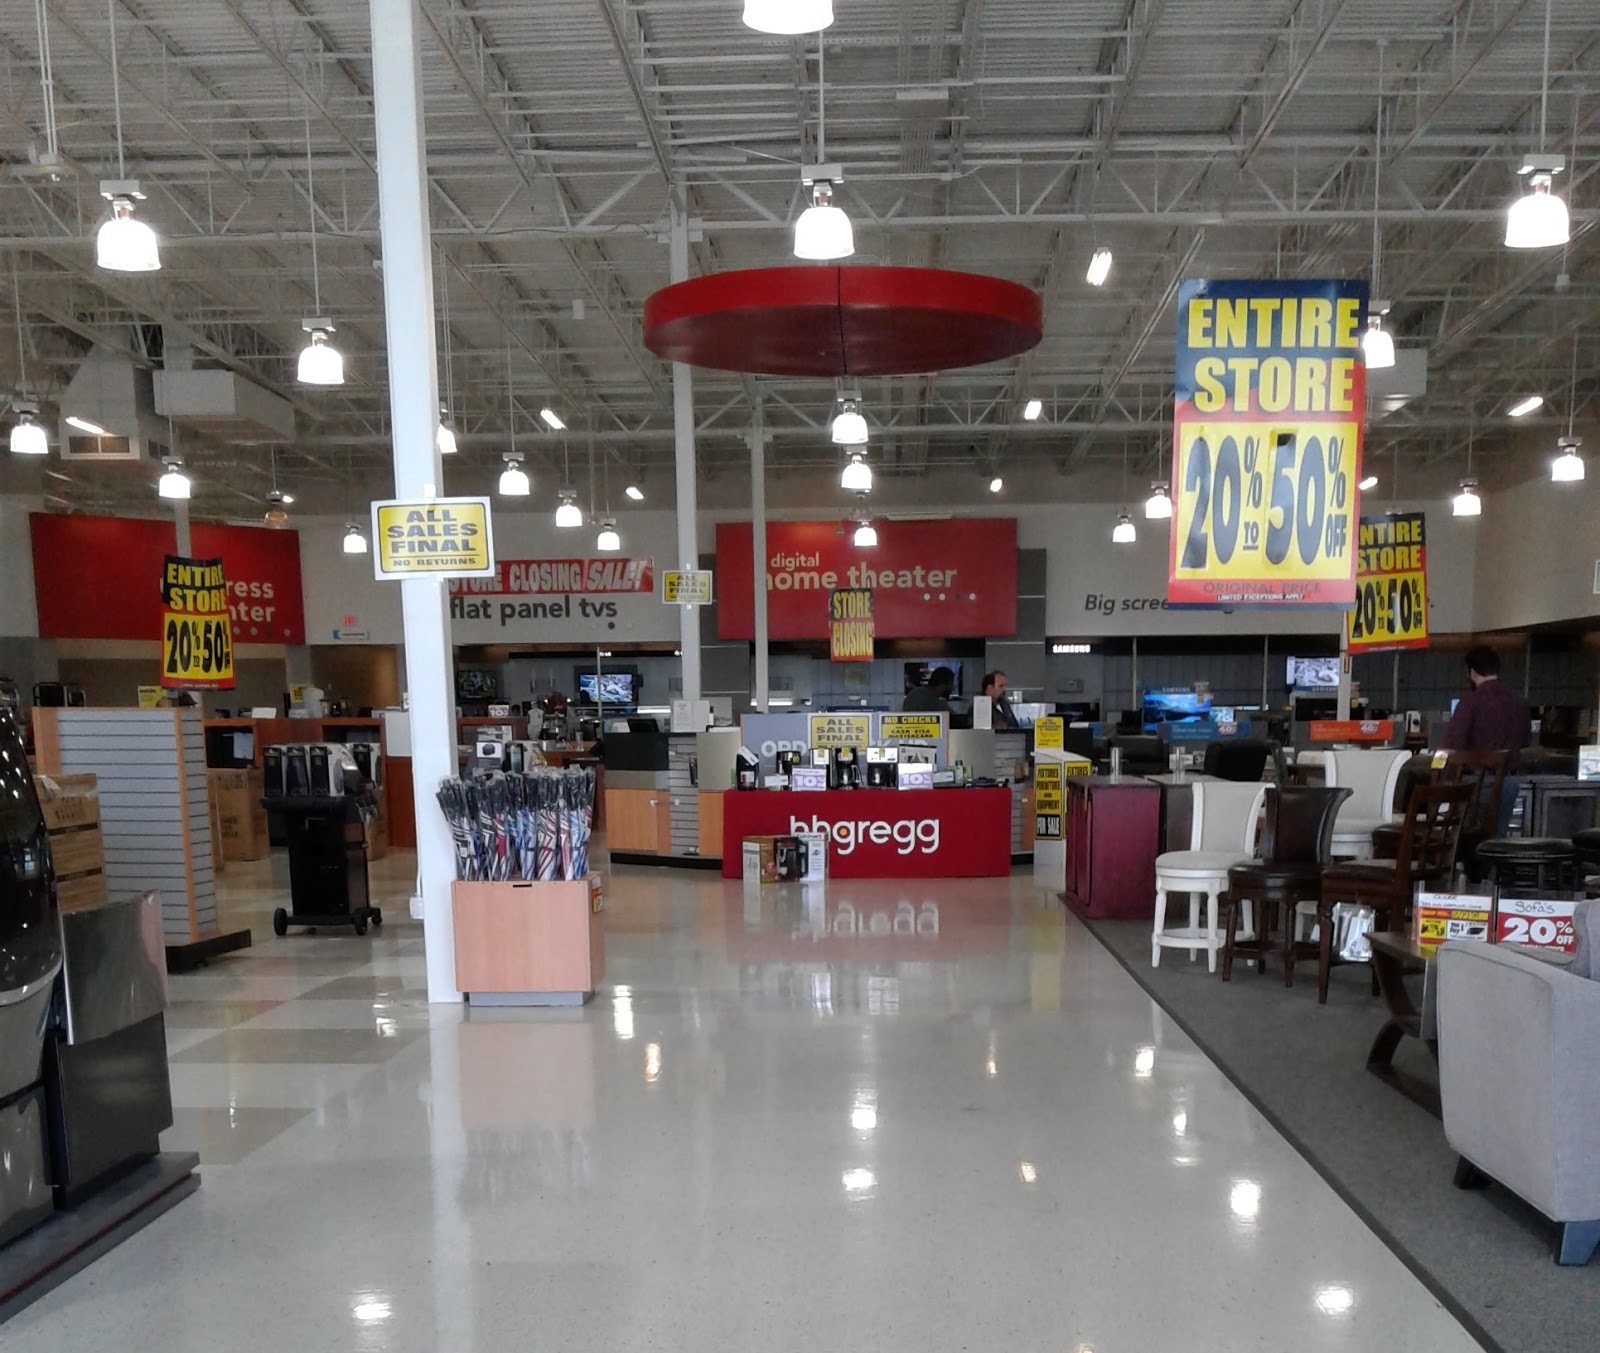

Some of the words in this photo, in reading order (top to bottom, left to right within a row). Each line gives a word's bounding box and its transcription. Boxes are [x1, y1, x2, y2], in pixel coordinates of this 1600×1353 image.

[1187, 297, 1360, 349] ENTIRE
[1194, 356, 1354, 413] STORE
[1180, 435, 1262, 569] 20%
[1243, 522, 1259, 550] TO
[1265, 433, 1346, 566] 50%
[1324, 514, 1347, 558] OFF
[406, 509, 458, 523] ALL
[387, 522, 478, 539] SALES
[1360, 520, 1422, 546] NTIRE
[390, 539, 477, 553] FINAL
[393, 558, 412, 566] NO
[416, 556, 476, 566] RETURNS
[770, 552, 820, 572] digital
[1356, 545, 1421, 573] STORE
[167, 562, 225, 587] ENTIRE
[509, 561, 582, 592] CLOSING
[847, 561, 958, 590] theater
[170, 587, 227, 612] STORE
[1203, 582, 1278, 594] ORIGINAL
[1281, 582, 1321, 594] PRICE
[450, 595, 492, 619] flat
[500, 594, 571, 626] panel
[578, 597, 618, 618] tvs
[833, 591, 871, 619] STORE
[1084, 593, 1116, 616] Big
[1121, 596, 1170, 612] scree
[833, 620, 873, 657] CLOSING
[816, 726, 865, 734] SALES
[826, 718, 854, 726] ALL
[884, 716, 898, 724] NO
[901, 716, 938, 724] CHECKS
[817, 734, 864, 742] FINAL
[1047, 816, 1060, 835] SALE
[1515, 901, 1555, 914] Sofa's
[1502, 917, 1574, 944] 20%
[1556, 935, 1574, 945] OFF
